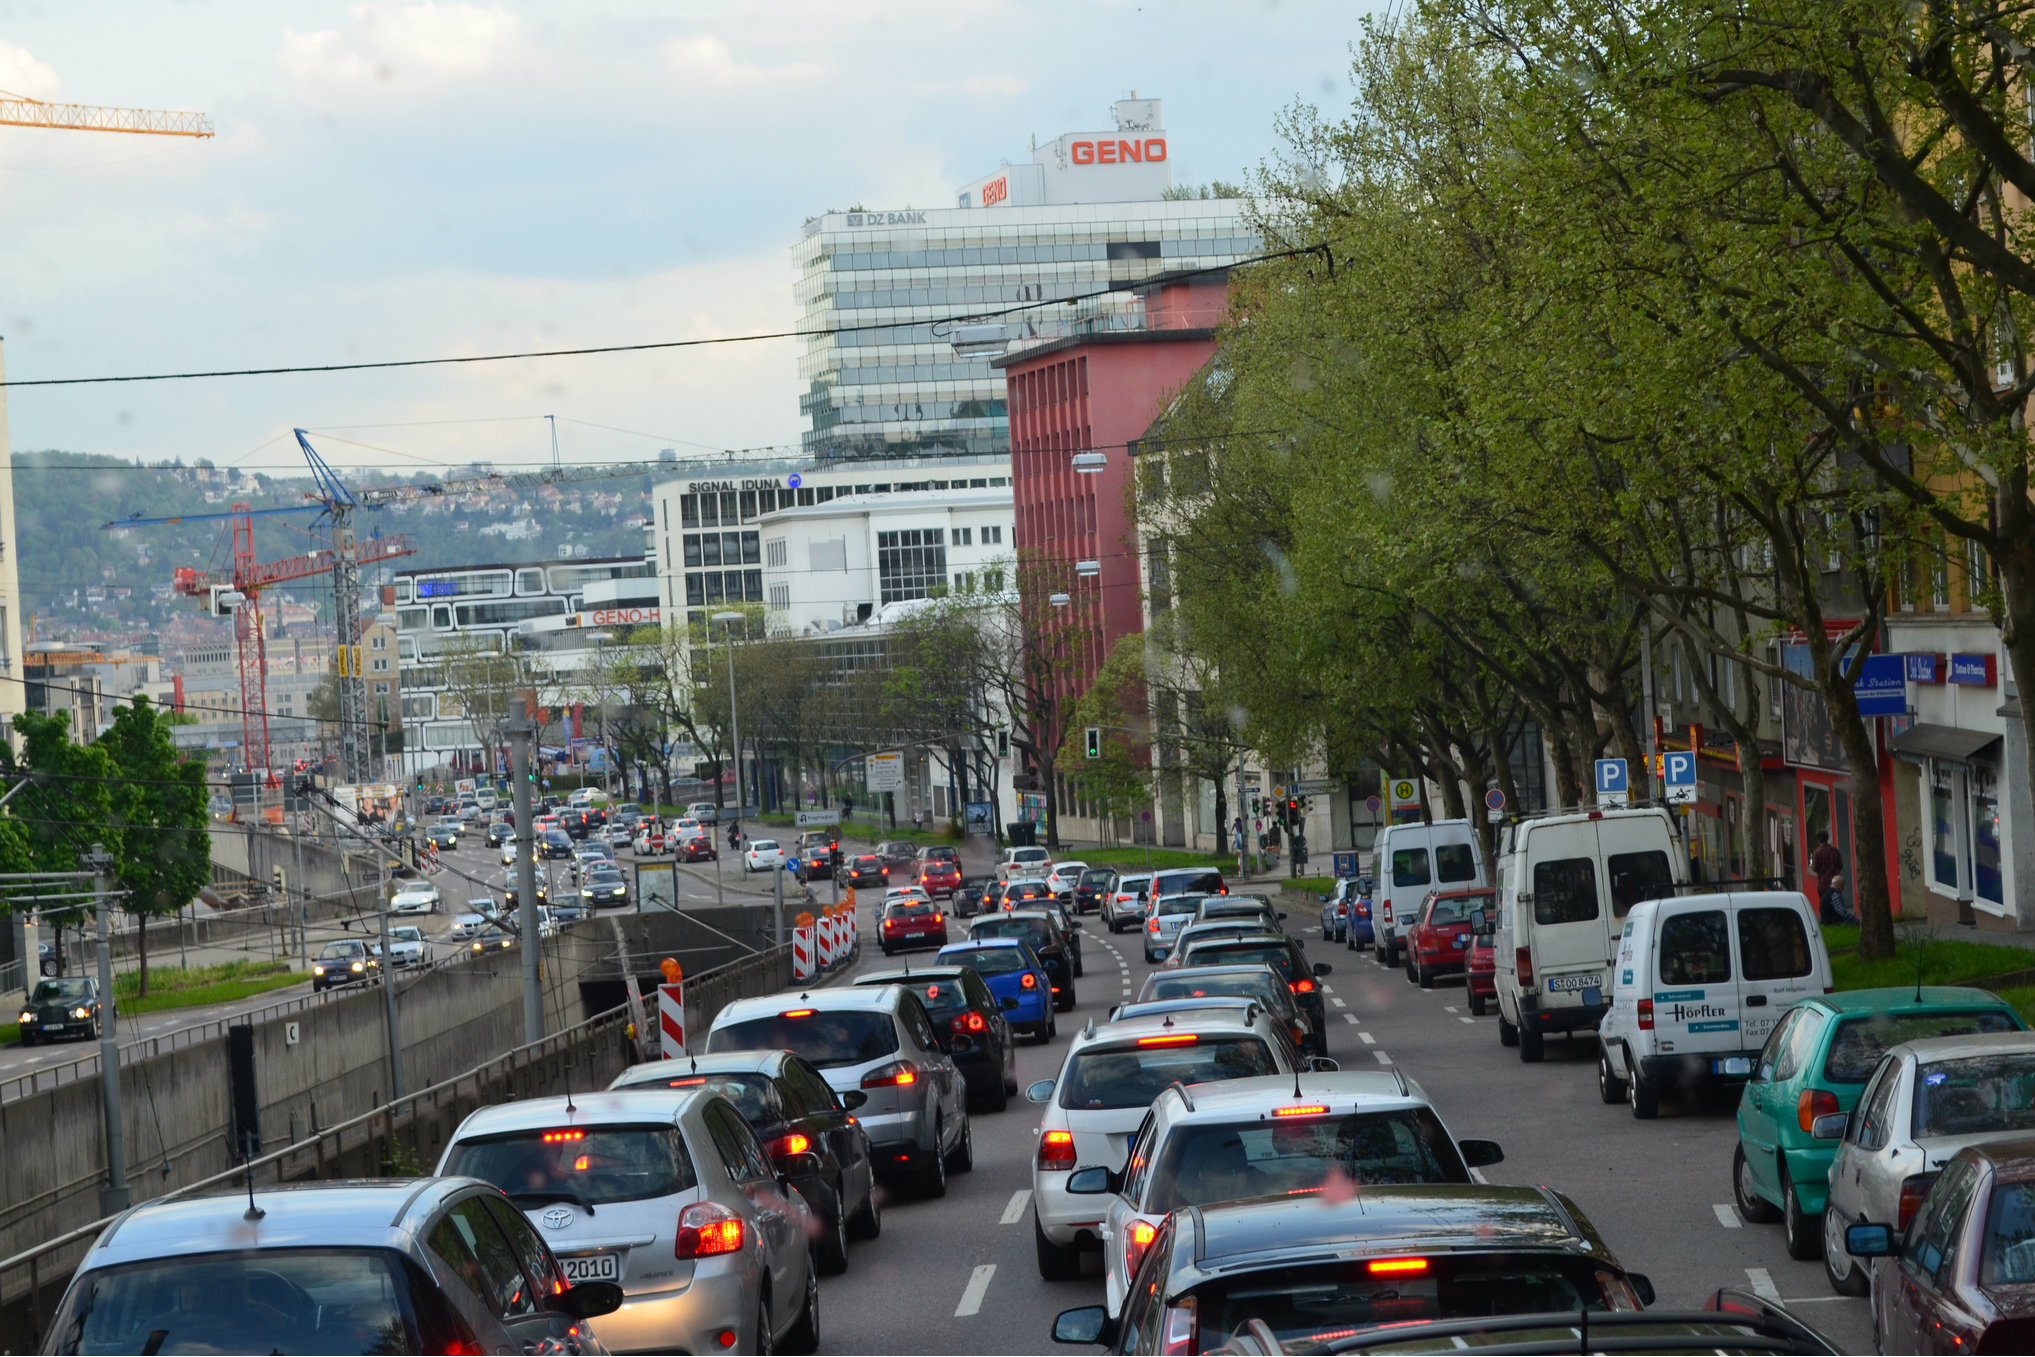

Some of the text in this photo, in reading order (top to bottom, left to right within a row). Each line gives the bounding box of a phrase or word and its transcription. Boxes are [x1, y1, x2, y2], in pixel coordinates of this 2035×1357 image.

[1071, 138, 1167, 165] GENO
[982, 176, 1007, 208] GENO
[867, 211, 926, 226] DZ BANK
[688, 478, 782, 493] SIGNAL IDUNA
[1867, 677, 1902, 688] Station
[1603, 763, 1620, 789] P
[1670, 756, 1688, 782] P
[1554, 980, 1560, 988] S
[1578, 976, 1600, 987] 8474
[289, 1025, 296, 1041] C
[566, 1258, 613, 1279] 2010
